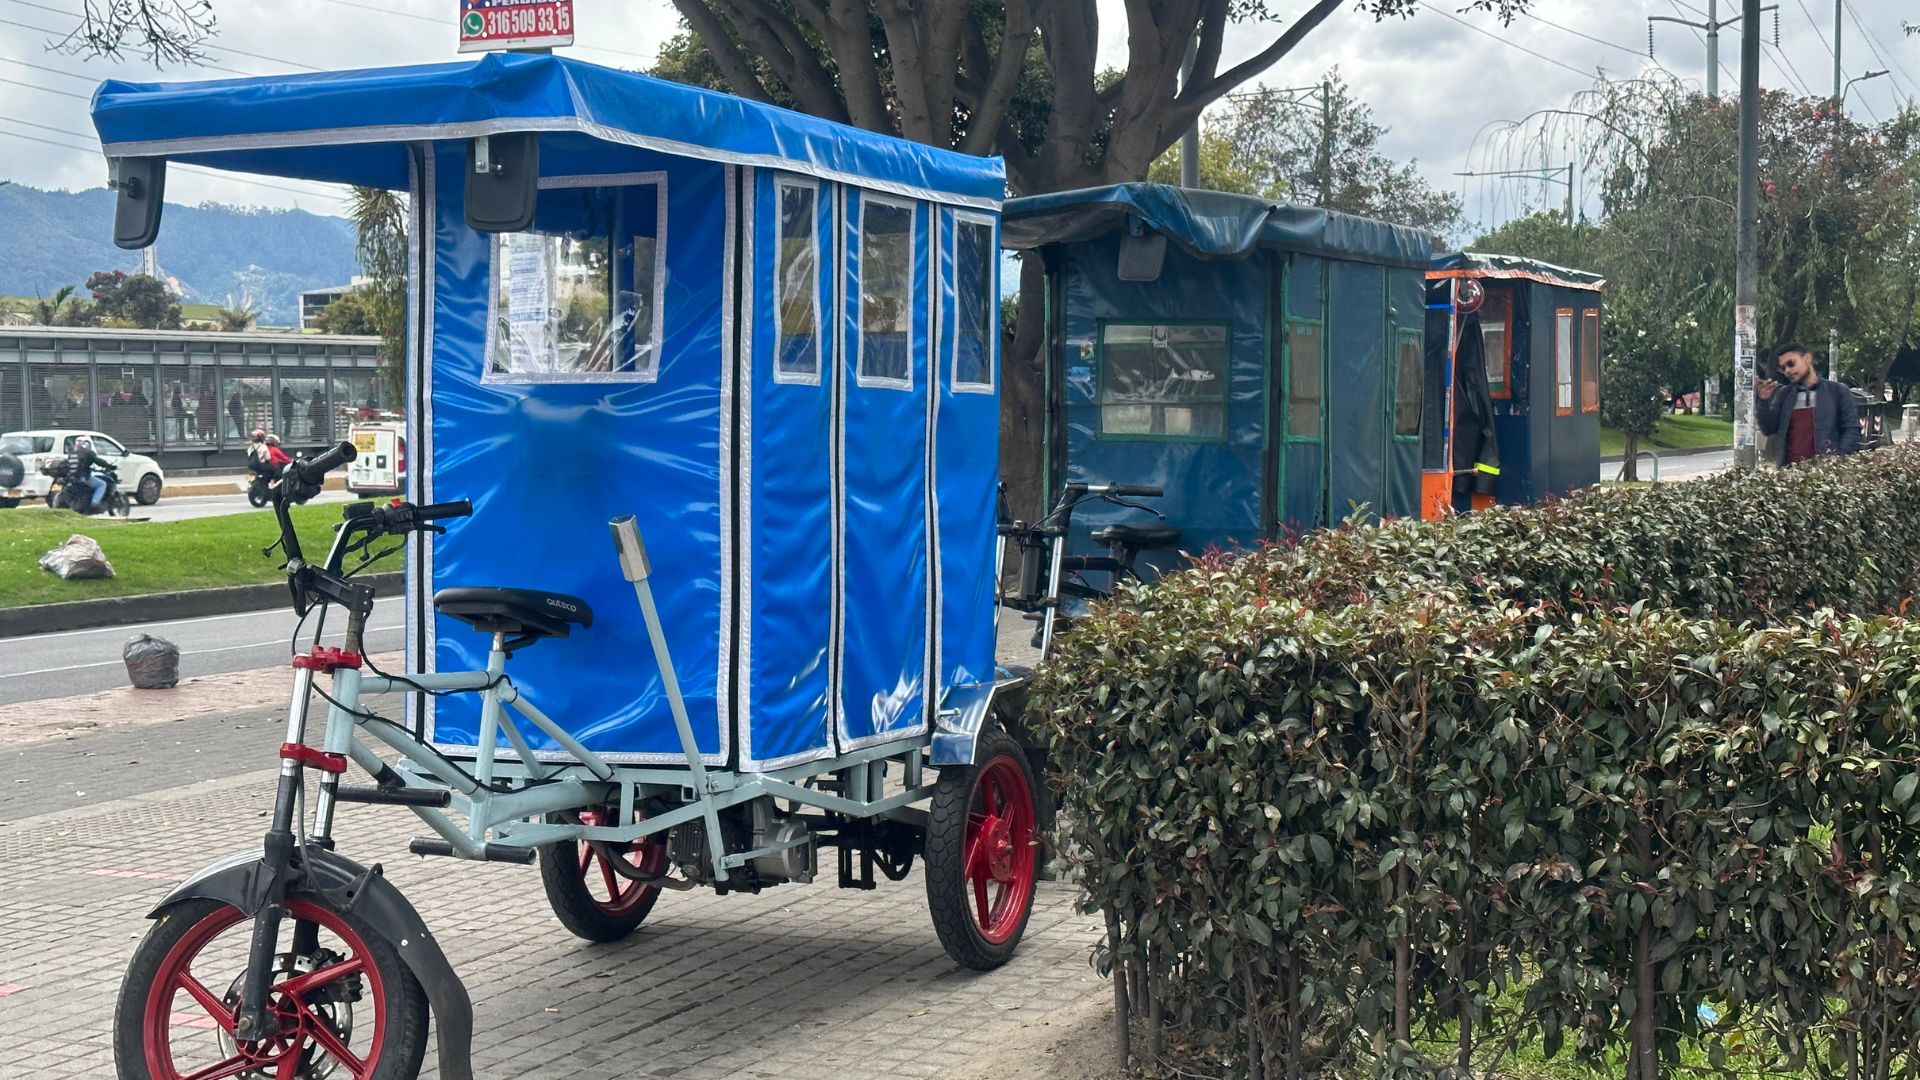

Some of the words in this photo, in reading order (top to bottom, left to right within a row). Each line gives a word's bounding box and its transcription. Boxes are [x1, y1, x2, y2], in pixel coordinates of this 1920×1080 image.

[488, 11, 510, 35] 316
[512, 9, 536, 34] 509
[538, 7, 554, 32] 33
[556, 6, 570, 31] 15
